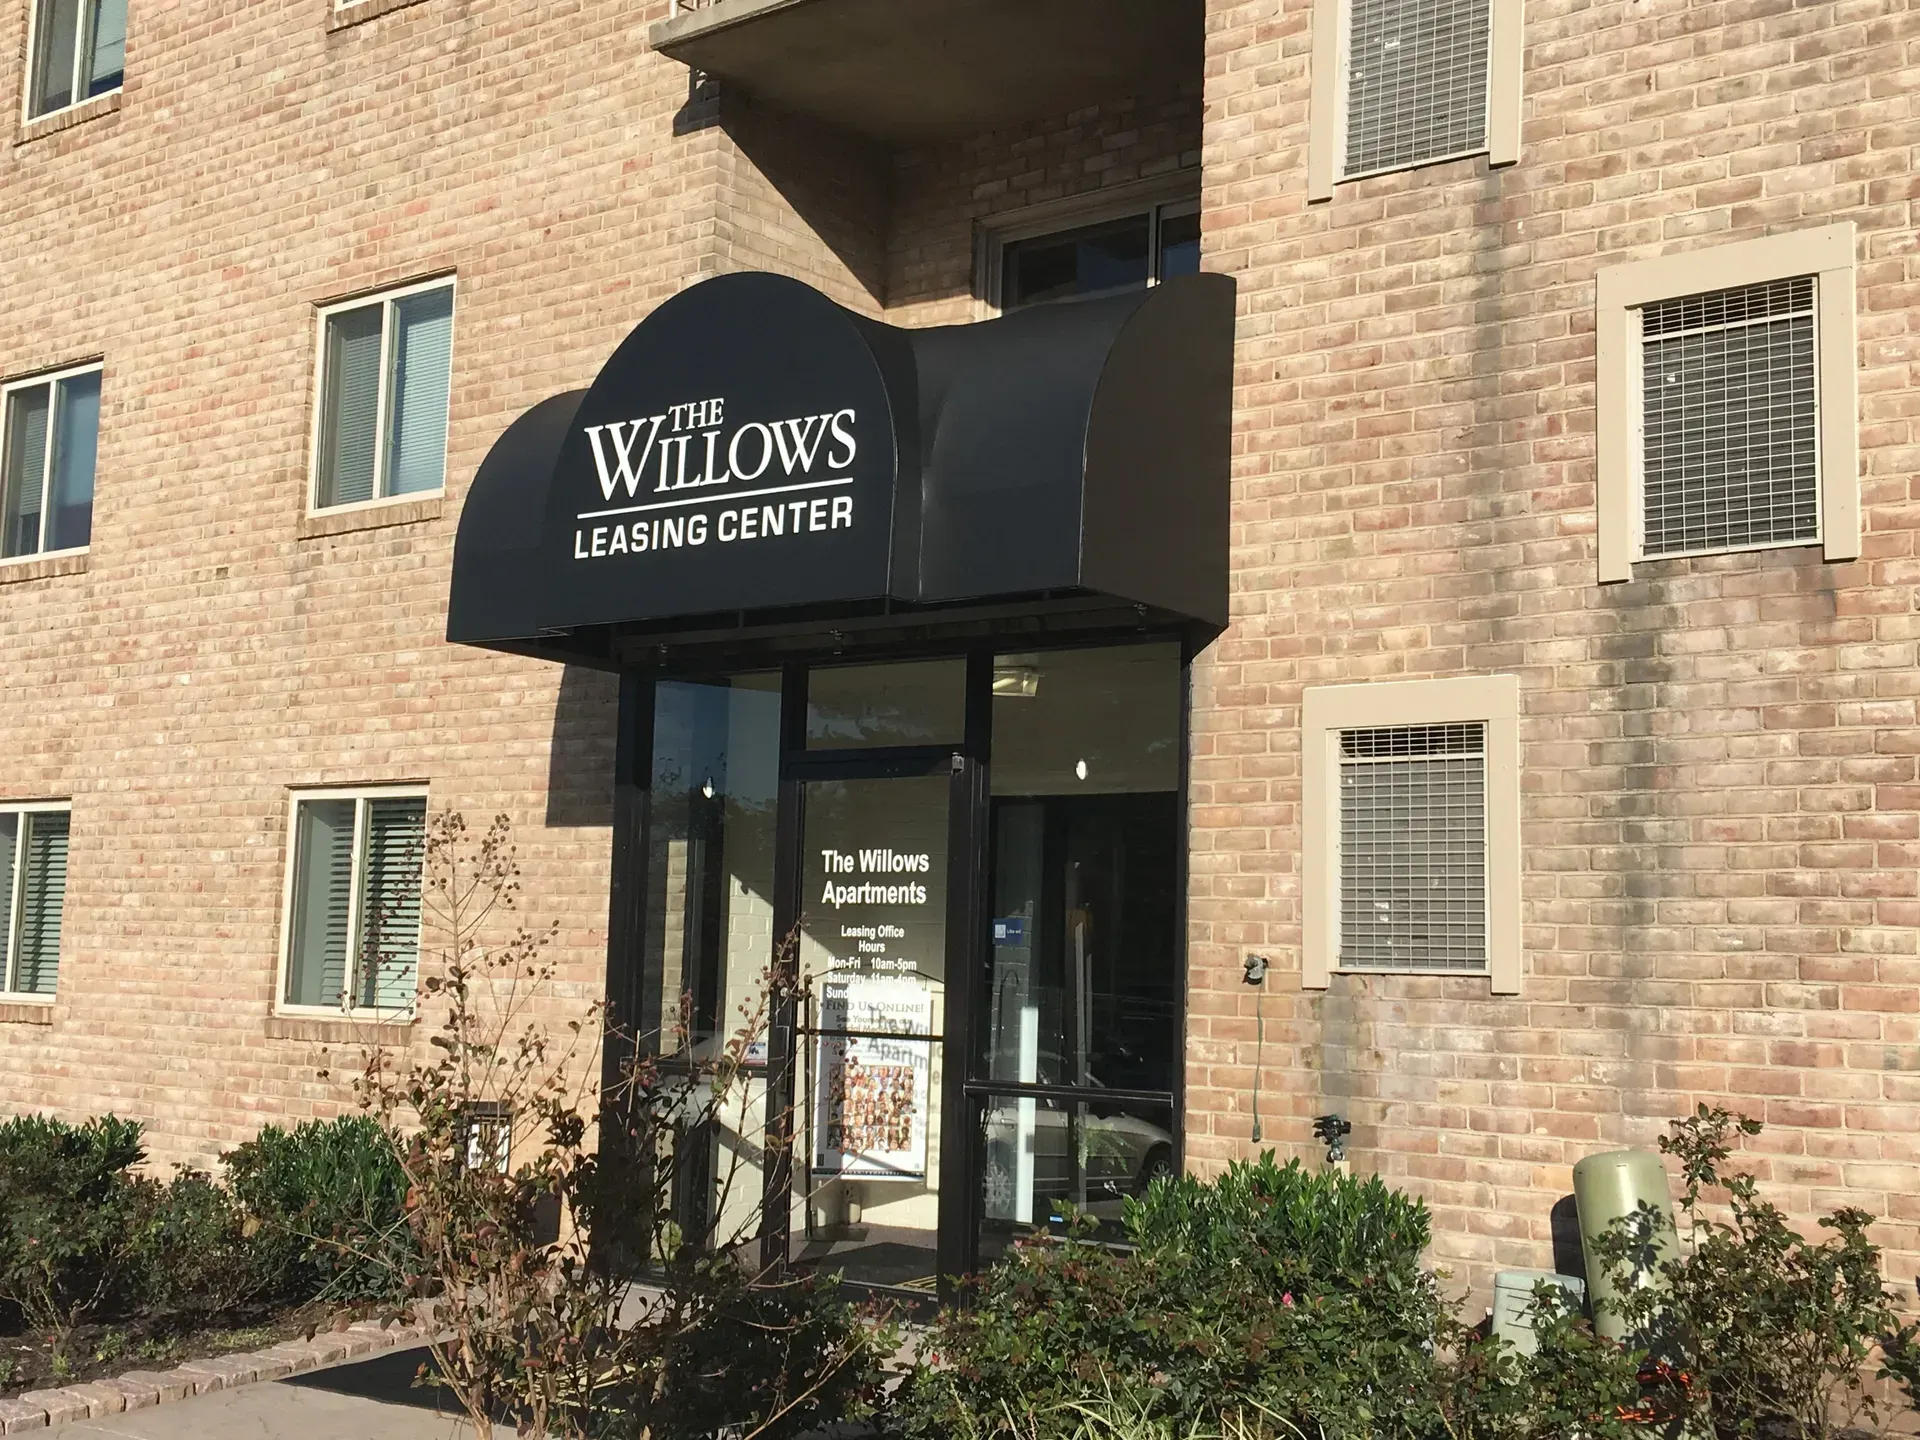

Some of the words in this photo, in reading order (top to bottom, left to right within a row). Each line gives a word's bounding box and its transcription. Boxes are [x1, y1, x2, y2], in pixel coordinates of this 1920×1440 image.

[668, 398, 724, 432] THE
[584, 409, 857, 501] WILLOWS
[574, 513, 708, 560] LEASING
[718, 496, 853, 543] CENTER
[821, 850, 854, 872] The
[859, 849, 930, 872] Willows
[821, 880, 927, 909] Apartments
[841, 925, 876, 940] Leasing
[878, 925, 905, 938] Office
[858, 940, 886, 952] Hours
[827, 956, 860, 969] Mon-Fri
[871, 957, 917, 972] 10am-5pm
[827, 972, 866, 986] Saturday
[826, 987, 848, 999] Sund
[826, 1000, 855, 1010] FIND
[876, 1002, 924, 1013] ONLINE!
